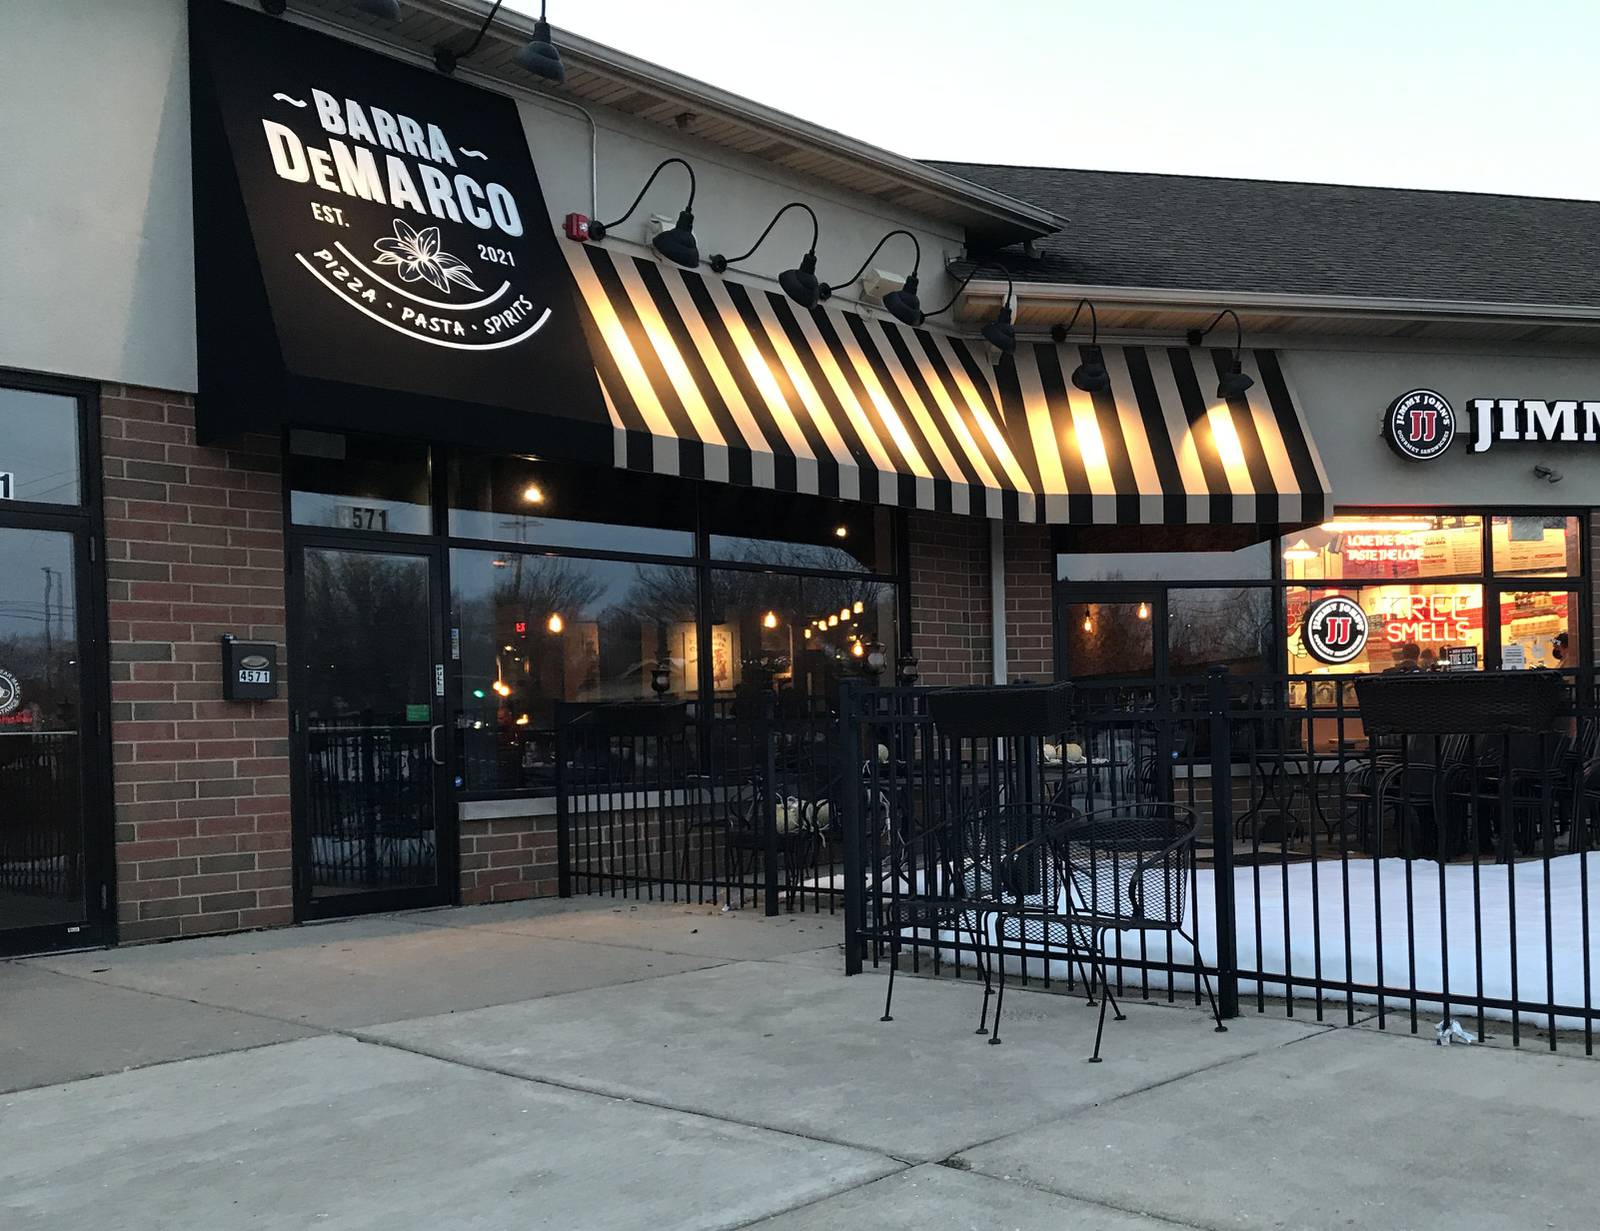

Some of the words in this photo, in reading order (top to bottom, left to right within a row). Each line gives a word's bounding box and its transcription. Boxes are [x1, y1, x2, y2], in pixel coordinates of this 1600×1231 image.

[311, 88, 457, 167] BARRA
[262, 119, 523, 237] DEMARCO
[310, 202, 350, 228] EST.
[477, 244, 515, 267] 2021
[313, 249, 376, 303] PIZZA
[401, 306, 465, 336] PASTA
[484, 294, 533, 335] SPIRITS
[1396, 395, 1421, 425] JIMMY
[1423, 395, 1450, 427] JOHN'S
[1410, 410, 1437, 441] JJ
[1326, 616, 1351, 645] JJ
[1386, 621, 1472, 642] SMELLS
[240, 670, 268, 682] 4571
